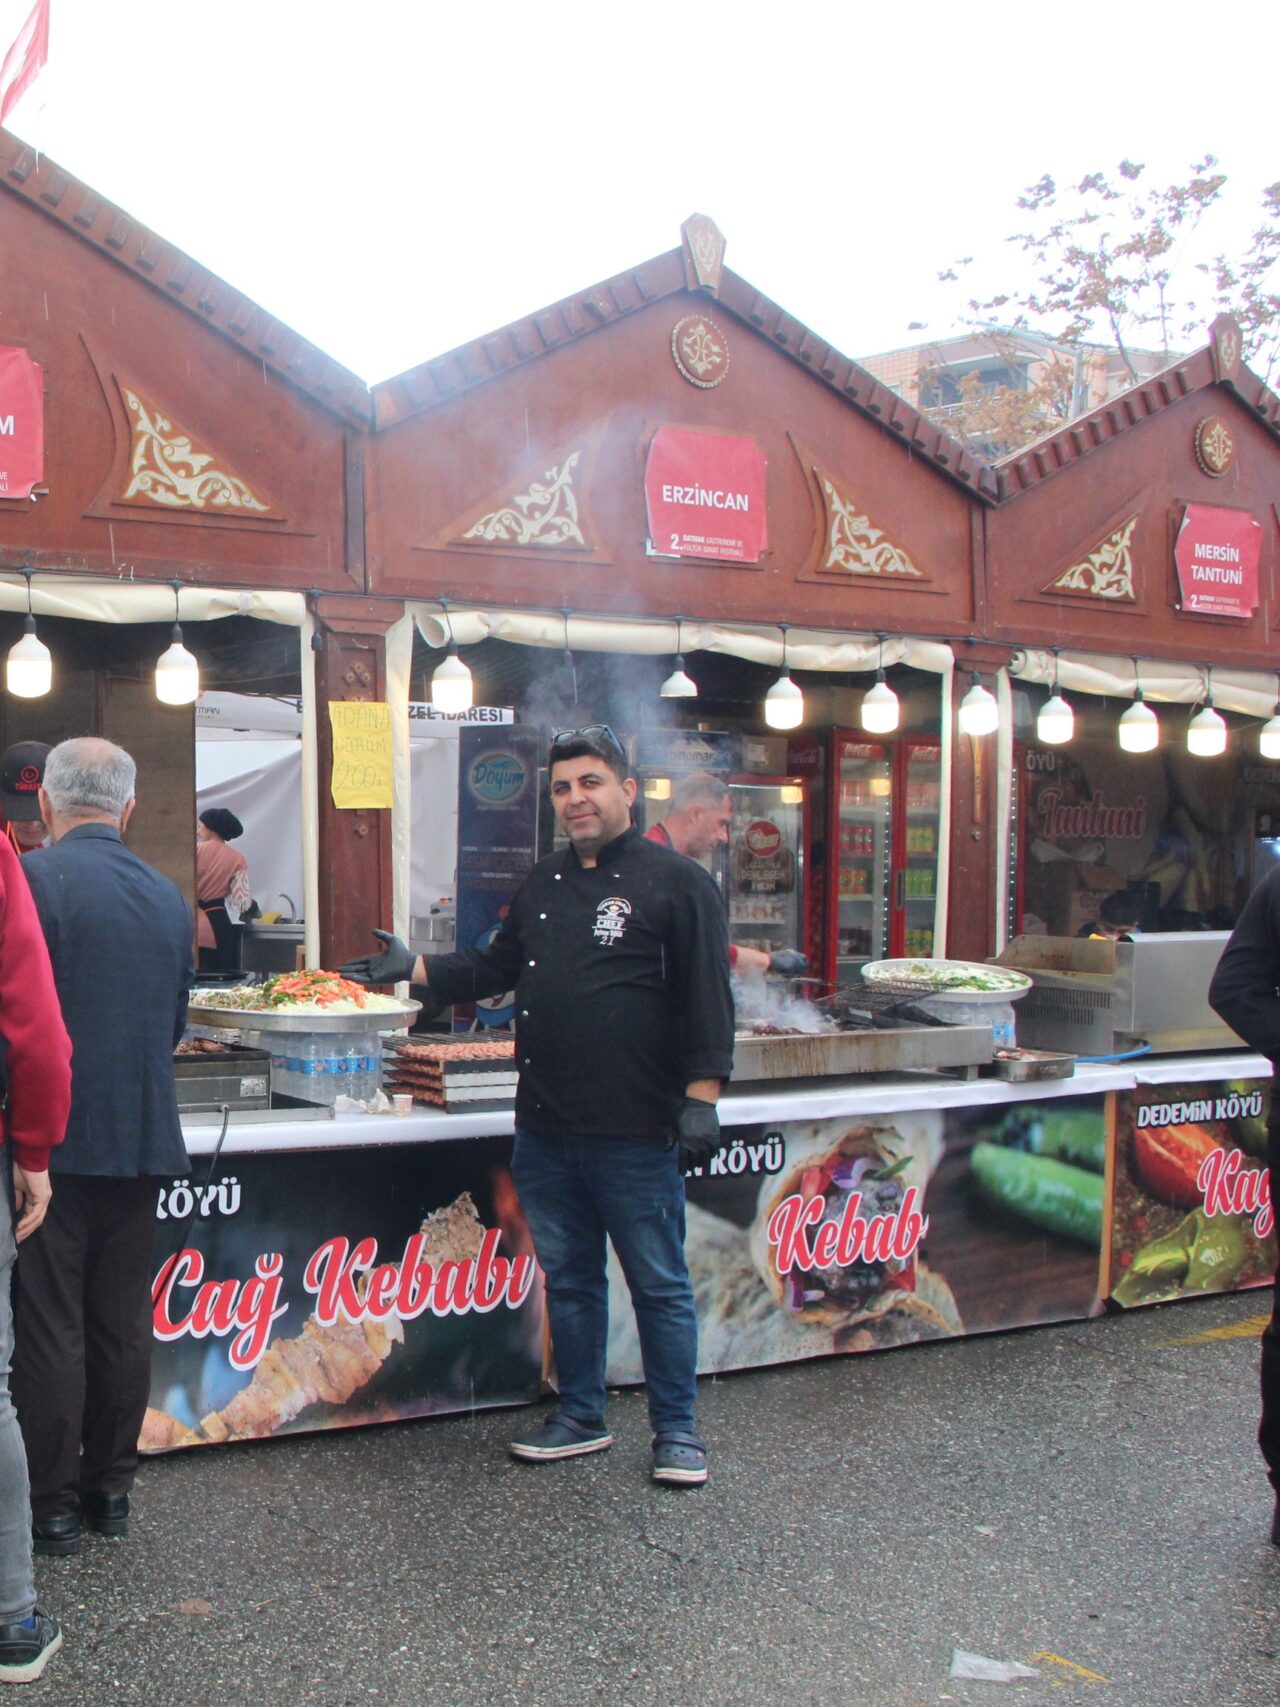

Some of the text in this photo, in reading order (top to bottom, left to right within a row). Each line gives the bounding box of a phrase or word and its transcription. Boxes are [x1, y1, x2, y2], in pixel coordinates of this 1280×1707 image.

[0, 471, 9, 480] VE
[662, 483, 749, 512] ERZİNCAN
[1194, 543, 1240, 562] MERSİN
[1191, 565, 1243, 585] TANTUNİ
[473, 763, 525, 791] Doyum
[1038, 787, 1146, 838] Tantuni
[1215, 1091, 1263, 1119] KÖYÜ
[767, 1186, 930, 1274] Kebab
[303, 1227, 535, 1327] Kebabı
